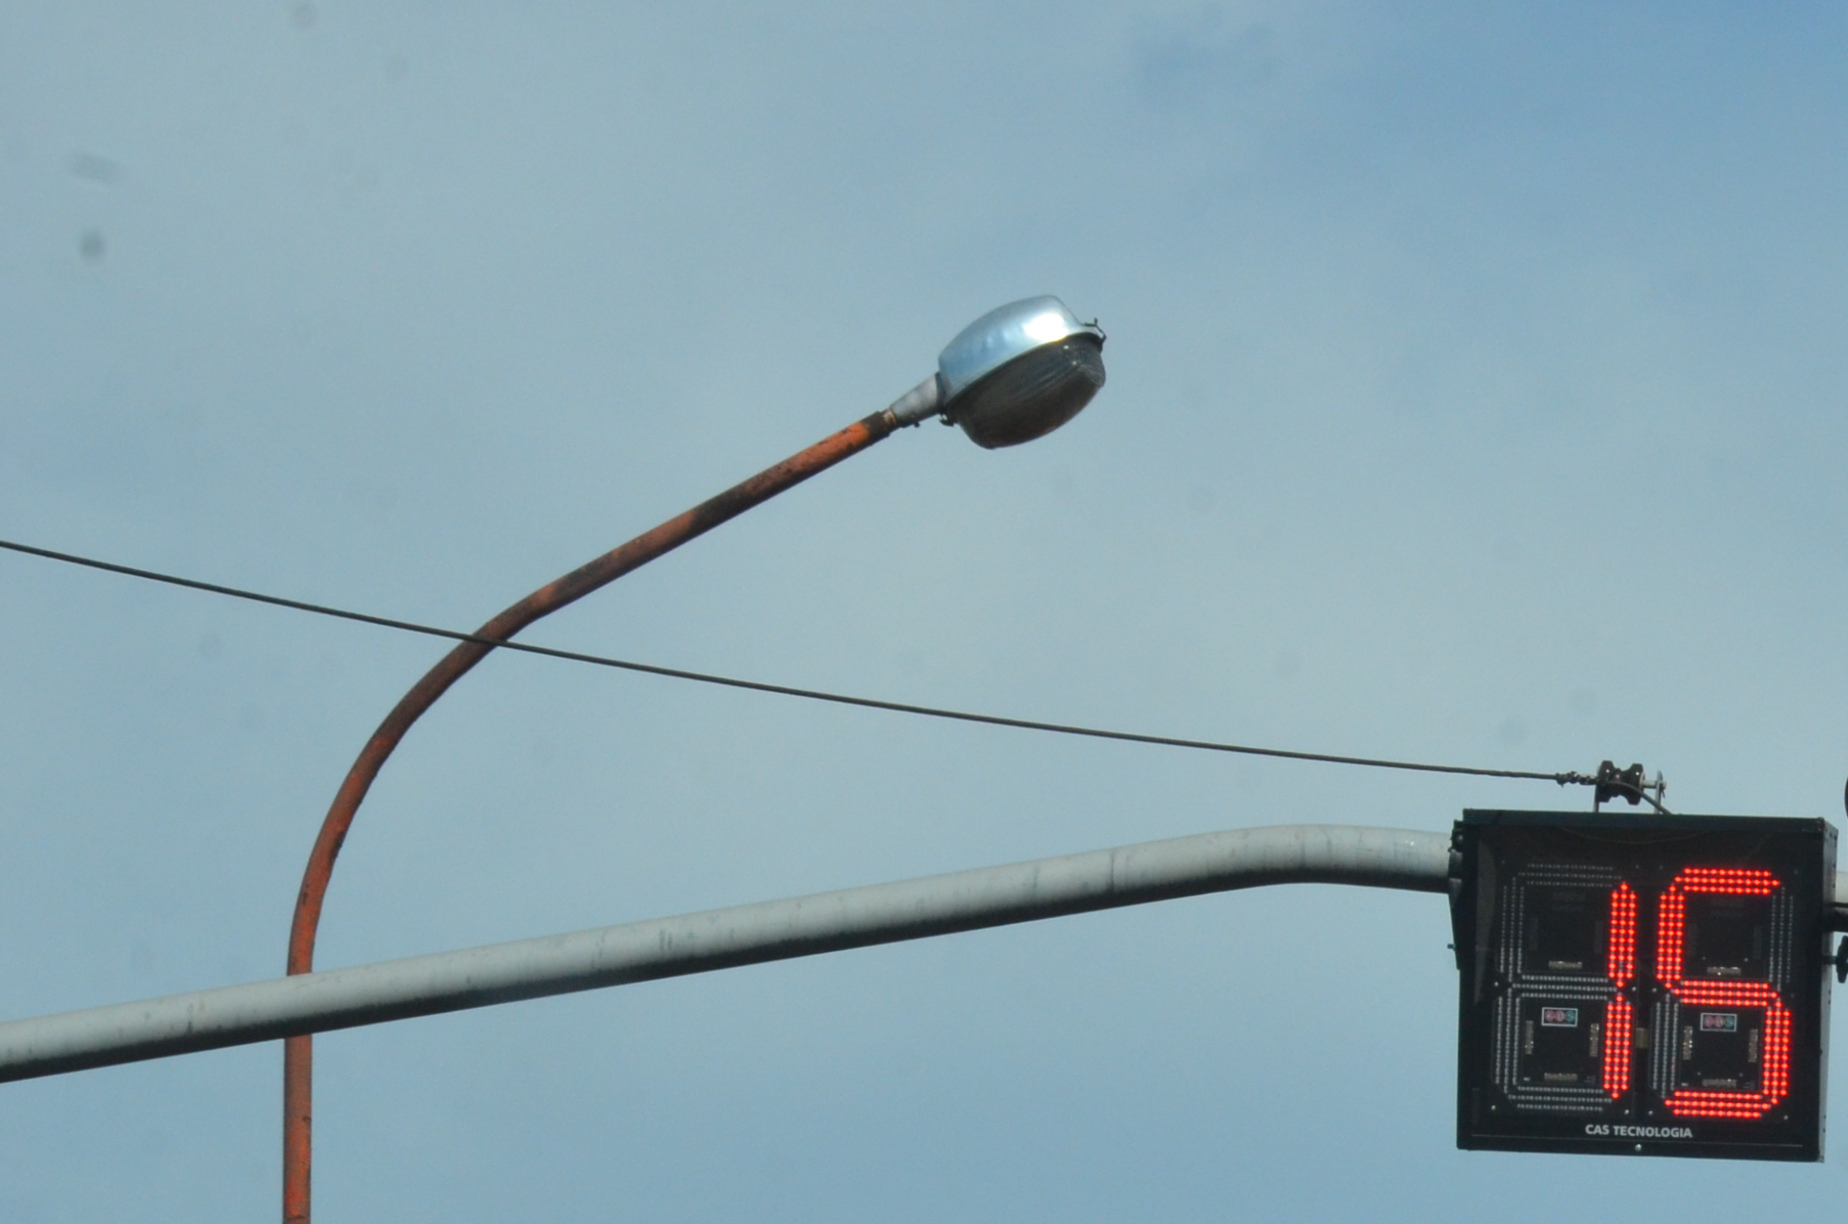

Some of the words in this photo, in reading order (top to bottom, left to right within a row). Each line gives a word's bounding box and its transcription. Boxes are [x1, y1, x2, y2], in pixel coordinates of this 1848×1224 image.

[1604, 868, 1791, 1118] 15
[1585, 1124, 1610, 1136] CAS
[1613, 1125, 1693, 1138] TECNOLOGIA
